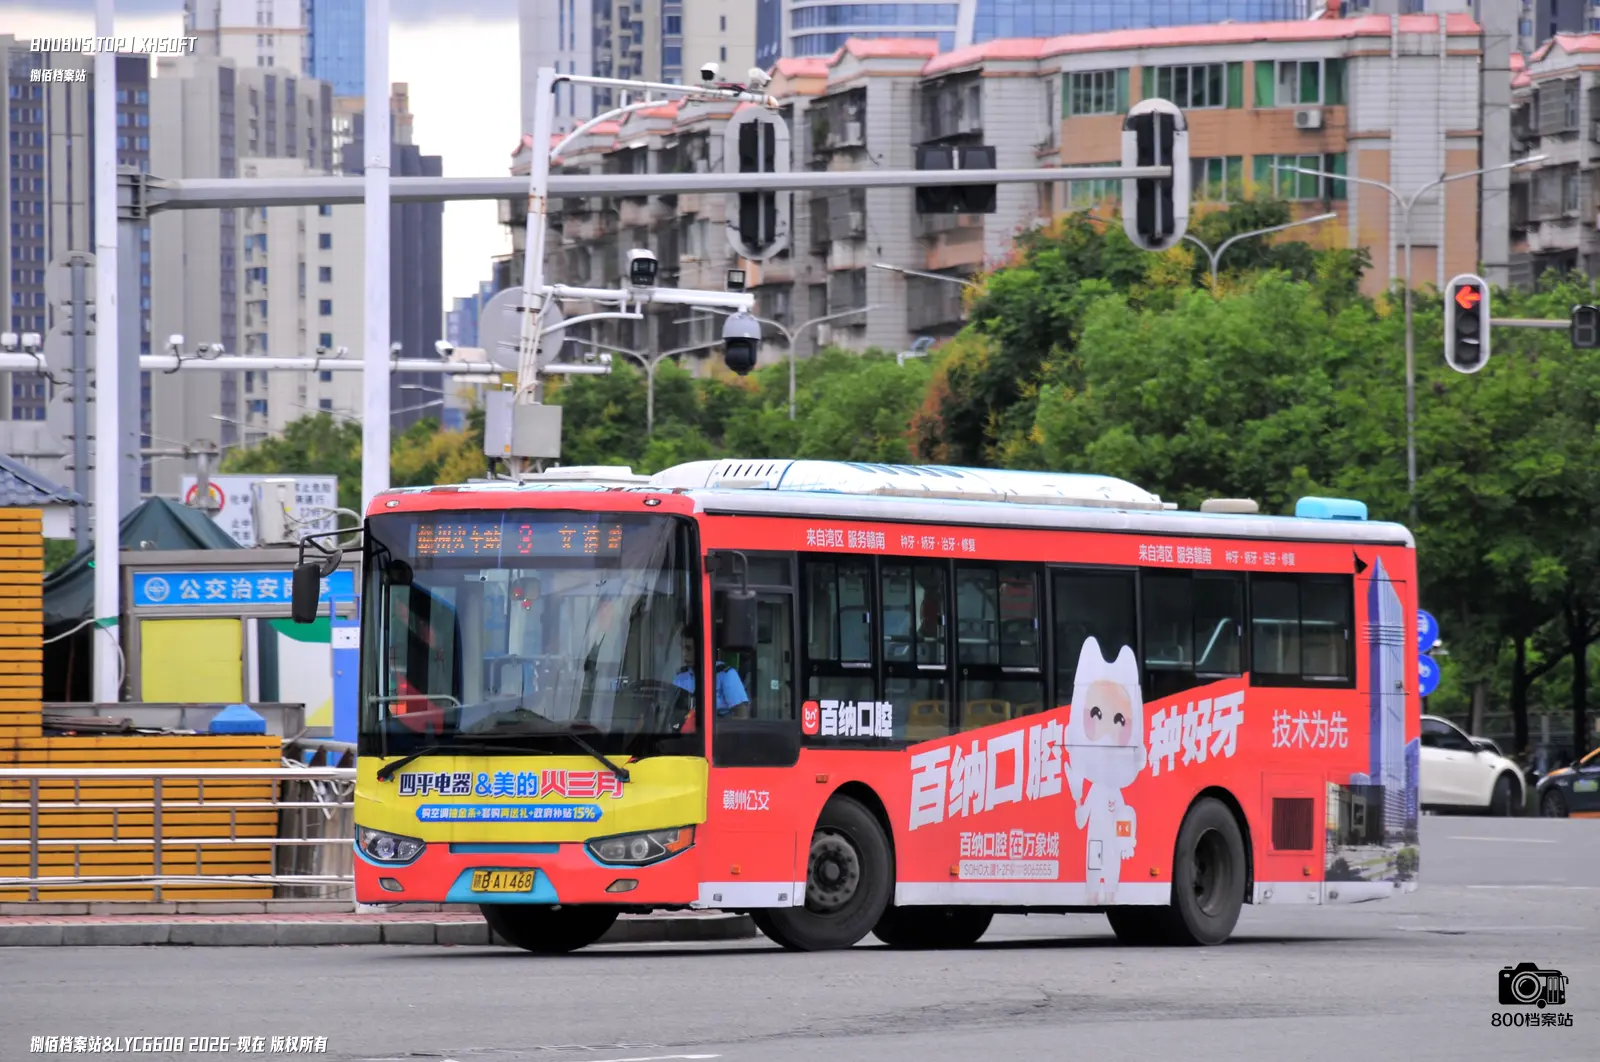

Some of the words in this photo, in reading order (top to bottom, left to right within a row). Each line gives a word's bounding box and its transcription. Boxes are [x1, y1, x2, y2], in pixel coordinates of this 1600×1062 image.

[517, 524, 533, 554] 3
[806, 528, 844, 547] 来自湾区
[848, 530, 886, 550] 服务赣南
[1138, 544, 1174, 563] 来自湾区
[1177, 546, 1212, 565] 服务赣南
[820, 699, 893, 738] 百纳口腔
[1148, 690, 1245, 777] 种好牙
[1271, 710, 1349, 750] 技术为先
[908, 718, 1067, 831] 百纳口腔
[722, 790, 770, 811] 赣州公交
